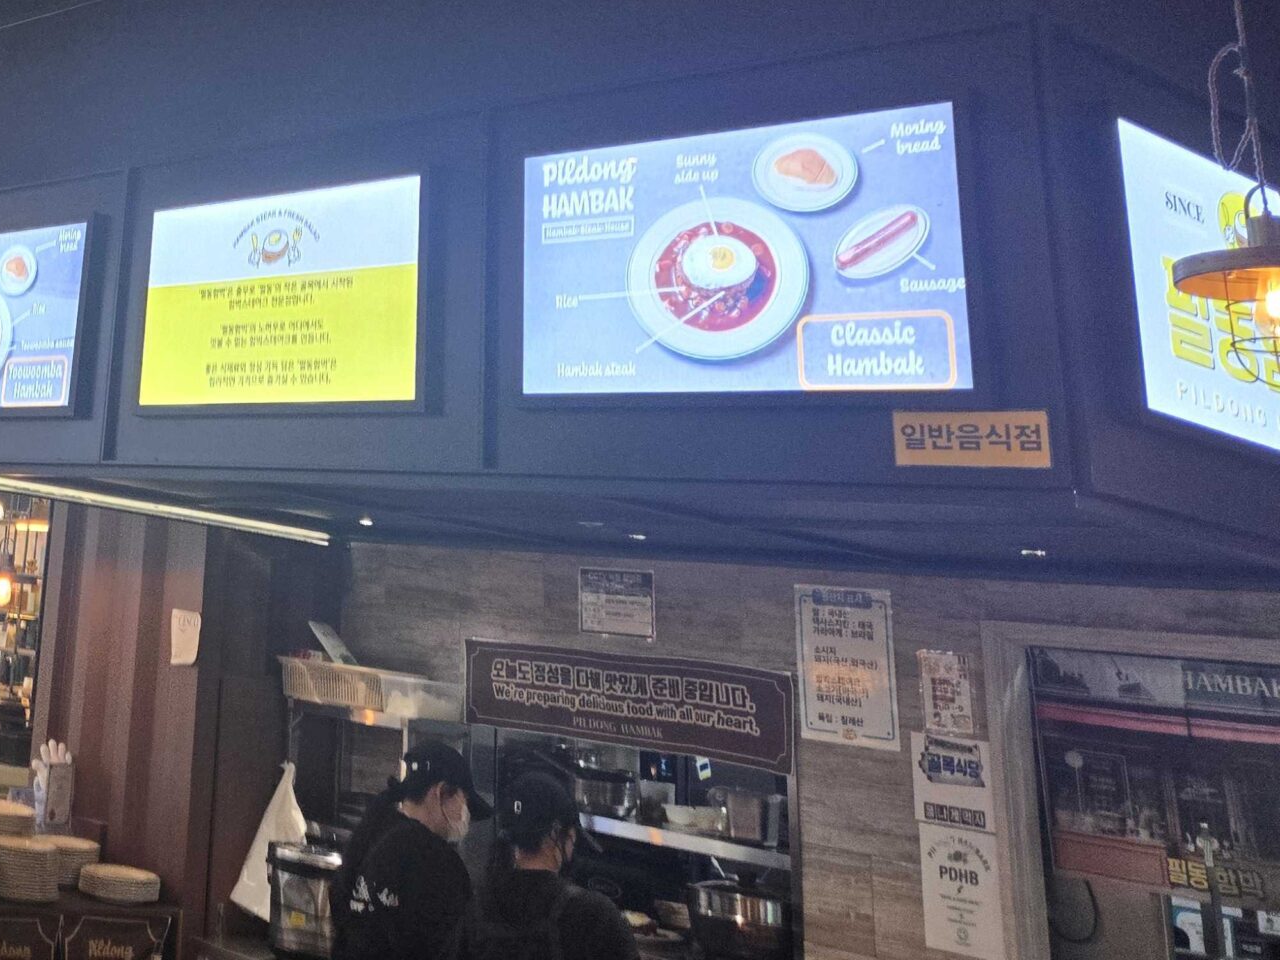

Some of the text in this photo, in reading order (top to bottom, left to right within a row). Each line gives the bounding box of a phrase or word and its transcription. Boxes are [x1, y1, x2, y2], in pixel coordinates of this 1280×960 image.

[897, 136, 941, 155] bread
[543, 155, 637, 187] Pildong
[676, 153, 716, 168] Sunny
[674, 169, 719, 184] side up
[543, 186, 634, 218] HAMBAK
[1164, 190, 1205, 224] SINCE
[900, 276, 966, 294] Sausage
[556, 296, 578, 309] Rice
[831, 320, 916, 347] Classic
[8, 361, 62, 381] Toowoomba
[557, 361, 636, 378] Hambak steak
[827, 349, 925, 378] Hambak
[14, 380, 53, 399] Hambak
[900, 422, 1042, 452] 일반음식점
[827, 609, 849, 618] 국내산
[814, 646, 836, 656] 소시지
[491, 658, 756, 713] 오늘도 정성을 다해 맛있게 준비 중입니다.
[492, 682, 761, 737] We're preparing delicious food with all our heart.
[573, 716, 664, 739] PILDONG HAMBAK
[927, 752, 980, 779] 골목식당
[939, 865, 979, 887] PDHB
